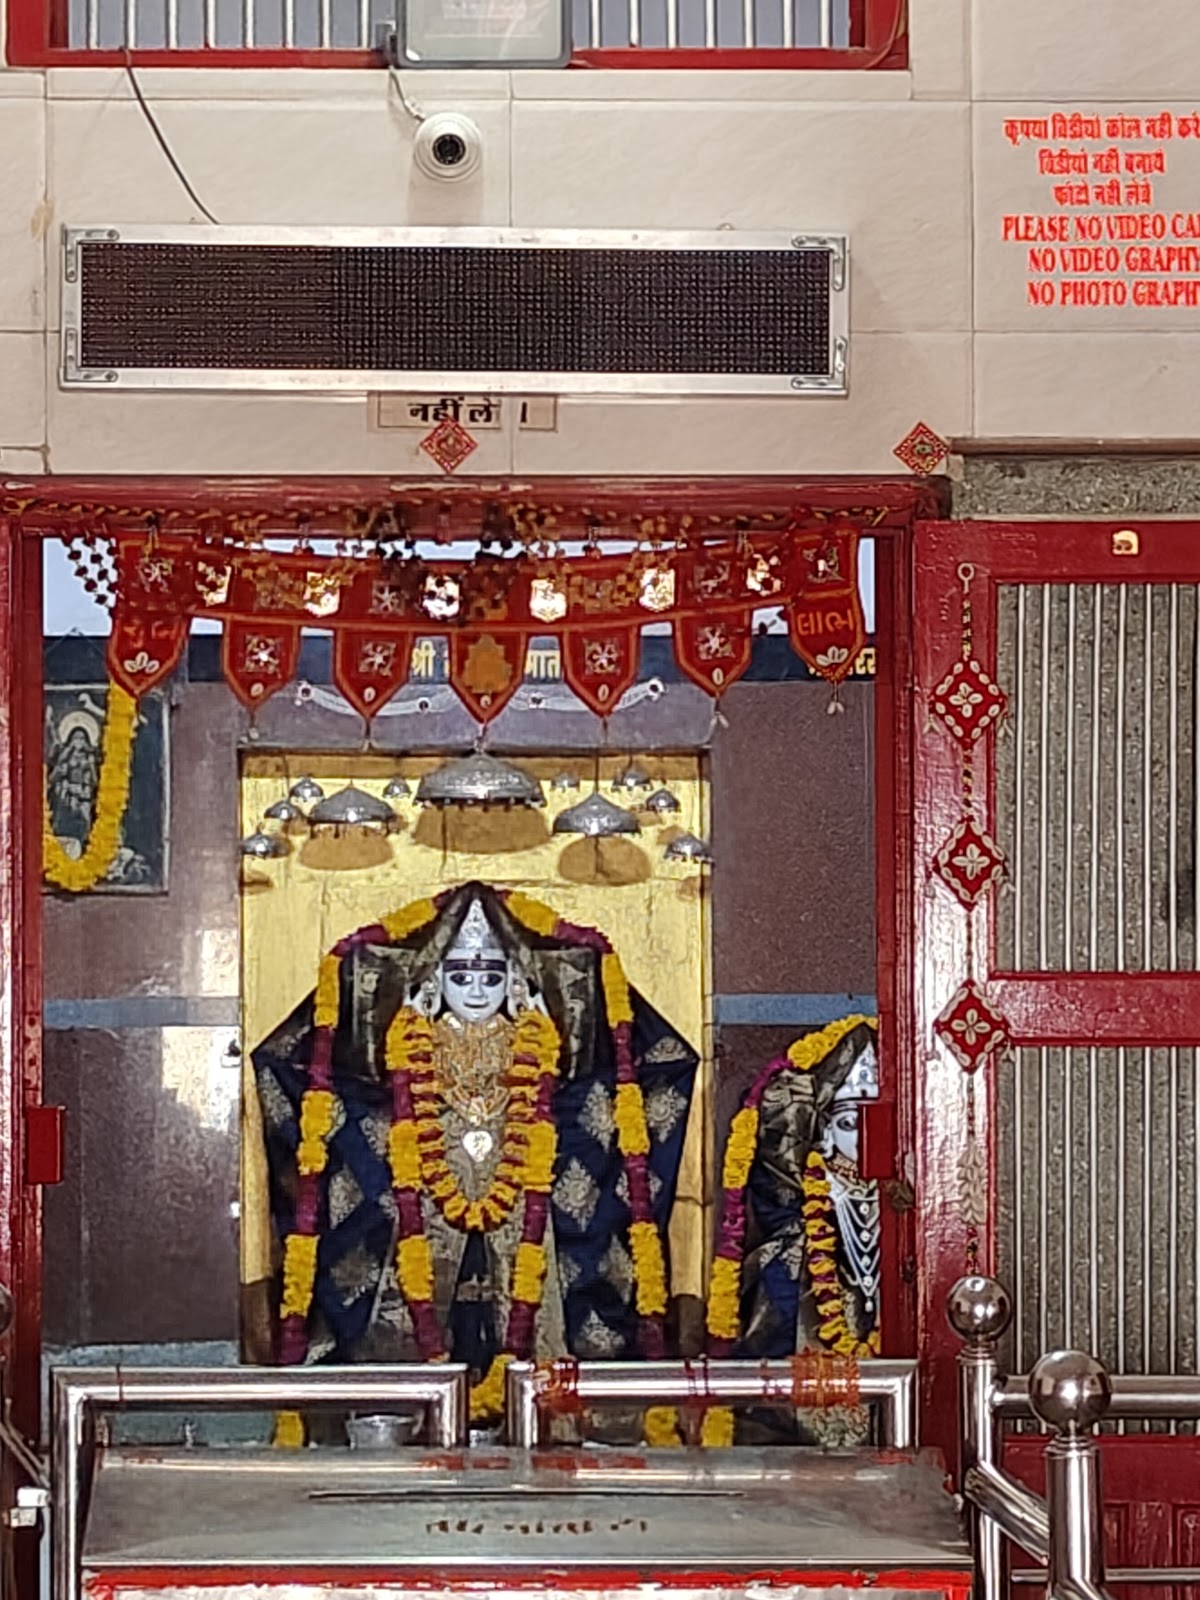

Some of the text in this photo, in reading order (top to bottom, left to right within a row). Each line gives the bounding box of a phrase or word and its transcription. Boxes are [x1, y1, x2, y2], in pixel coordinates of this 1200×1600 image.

[1003, 118, 1048, 146] कृपया
[1003, 213, 1200, 241] PLEASE NO VIDEO CA
[1028, 248, 1056, 272] NO
[1060, 246, 1120, 272] VIDEO
[1027, 280, 1200, 306] NO PHOTO GRAPH
